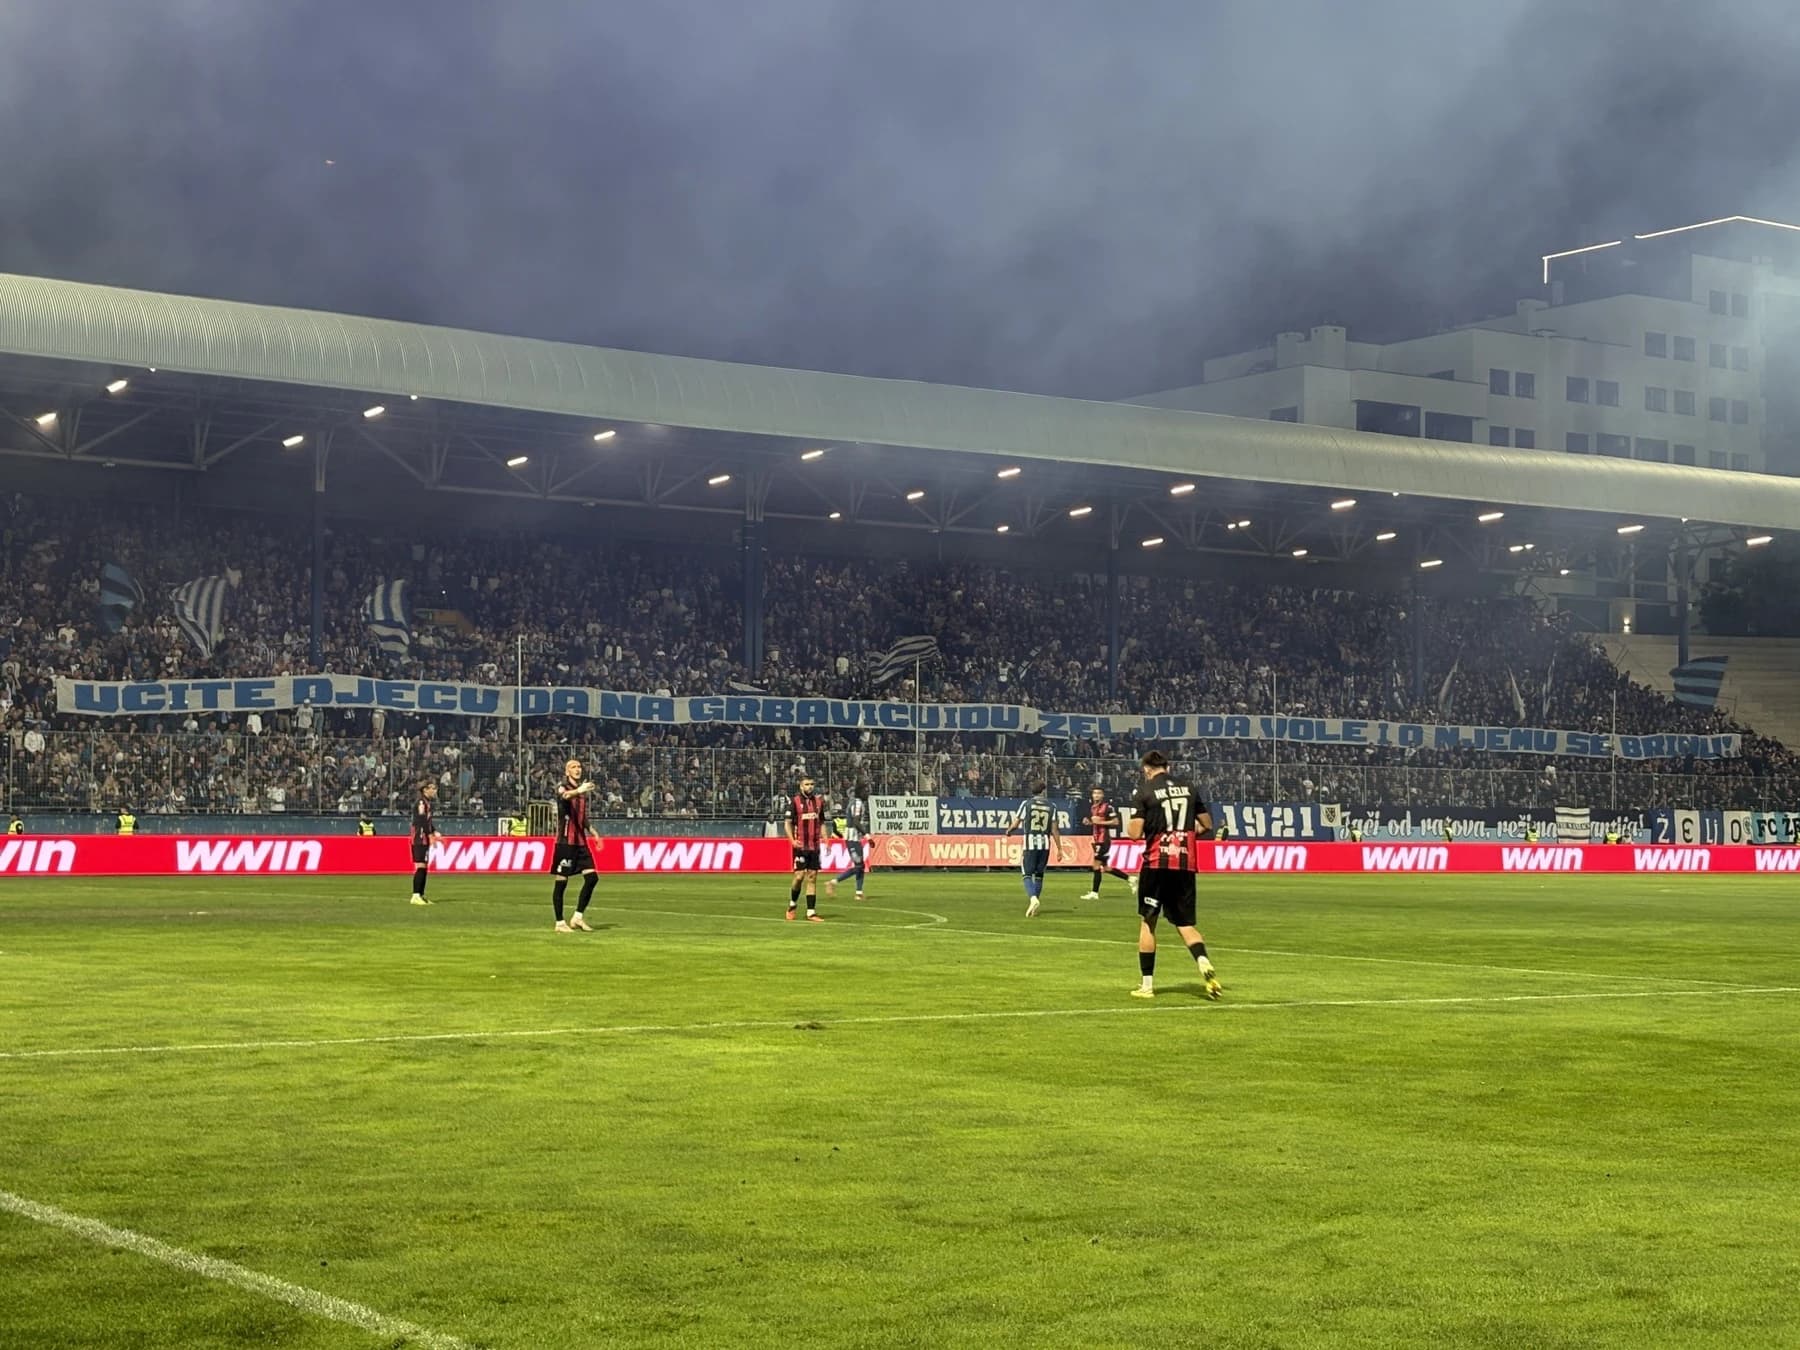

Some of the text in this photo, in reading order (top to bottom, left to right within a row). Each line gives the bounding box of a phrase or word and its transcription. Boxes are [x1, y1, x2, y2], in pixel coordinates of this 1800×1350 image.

[293, 678, 499, 713] DJECU
[514, 688, 589, 715] DA
[601, 692, 675, 722] NA
[1198, 716, 1250, 737] DA
[1260, 717, 1368, 742] VOLE
[1377, 723, 1389, 745] I
[1435, 727, 1557, 752] NJEMU
[1566, 732, 1610, 755] SE
[875, 799, 929, 808] VOLIM MAJKO
[939, 803, 1071, 829] ŽELJEZR
[1161, 797, 1188, 832] 17
[886, 821, 903, 831] SVOG
[1030, 810, 1049, 832] 23
[1222, 805, 1314, 838] 1921
[1388, 810, 1411, 837] od
[1420, 815, 1490, 838] raova,
[176, 840, 323, 871] wwin
[623, 842, 743, 870] wwin
[929, 838, 1022, 865] wwin lig
[1214, 846, 1307, 870] wwin
[1361, 846, 1449, 870] wwin
[1501, 847, 1583, 870] wwin
[1634, 848, 1711, 870] wwin
